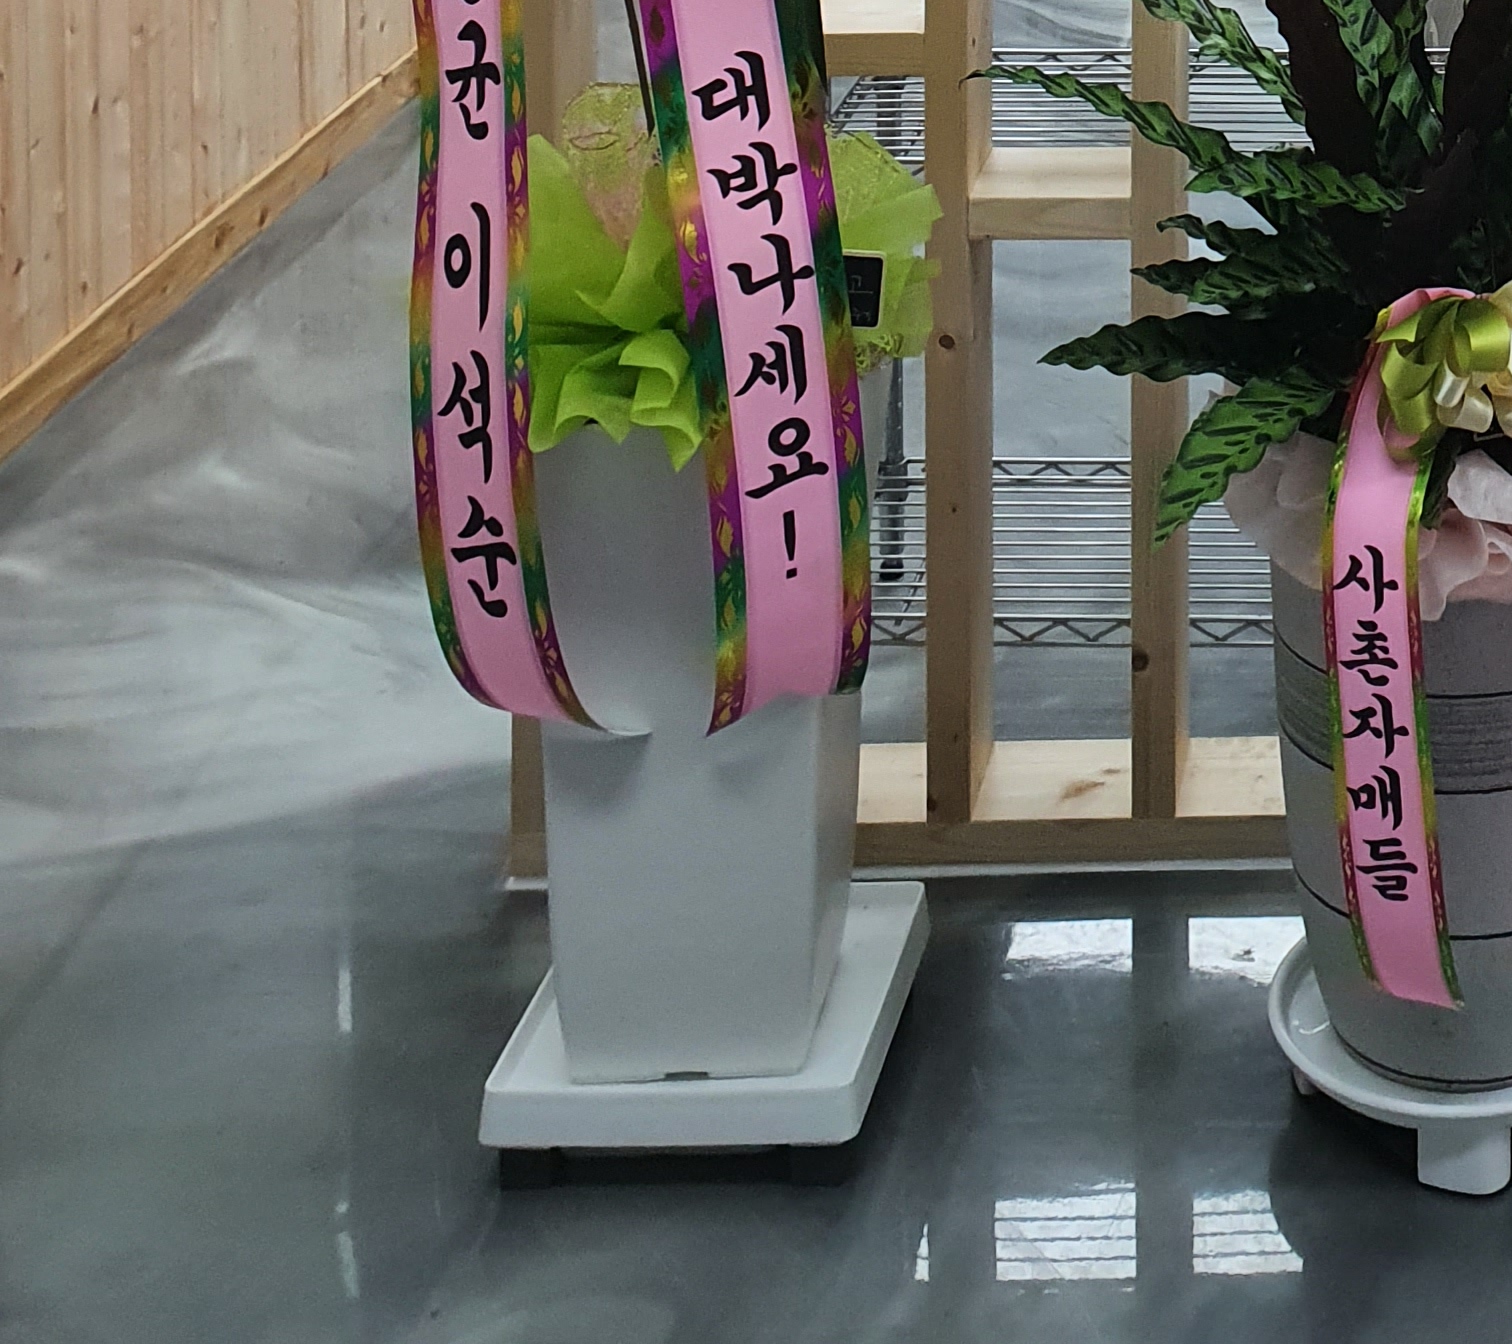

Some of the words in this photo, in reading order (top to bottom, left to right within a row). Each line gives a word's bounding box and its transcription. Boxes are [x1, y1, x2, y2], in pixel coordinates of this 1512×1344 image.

[438, 201, 518, 619] 이석순
[691, 50, 830, 580] 대박나세요!
[1333, 544, 1419, 903] 사촌자매들
